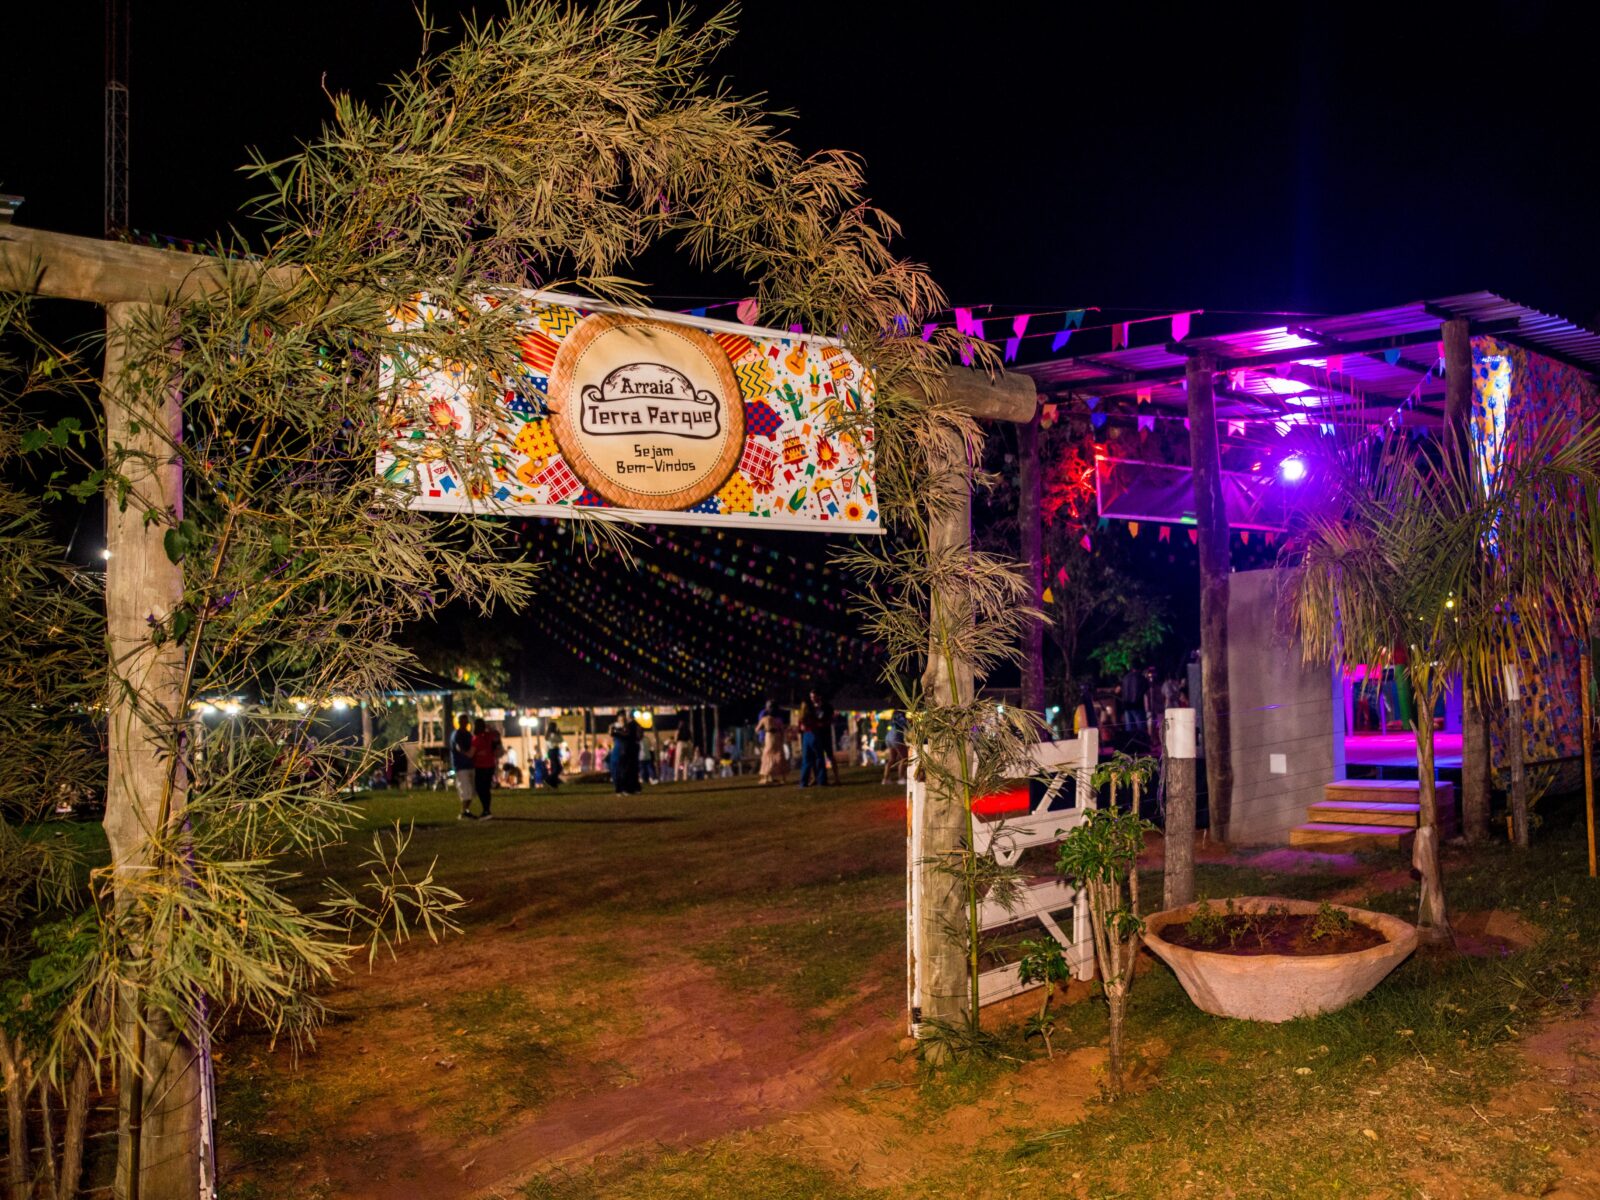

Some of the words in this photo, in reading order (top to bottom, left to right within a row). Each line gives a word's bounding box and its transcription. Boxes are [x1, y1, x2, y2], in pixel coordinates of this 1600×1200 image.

[620, 377, 674, 395] Arraiá
[588, 405, 642, 425] Terra
[647, 406, 713, 430] Parque
[634, 444, 674, 460] Sejam
[616, 459, 697, 474] Bem-Vindos
